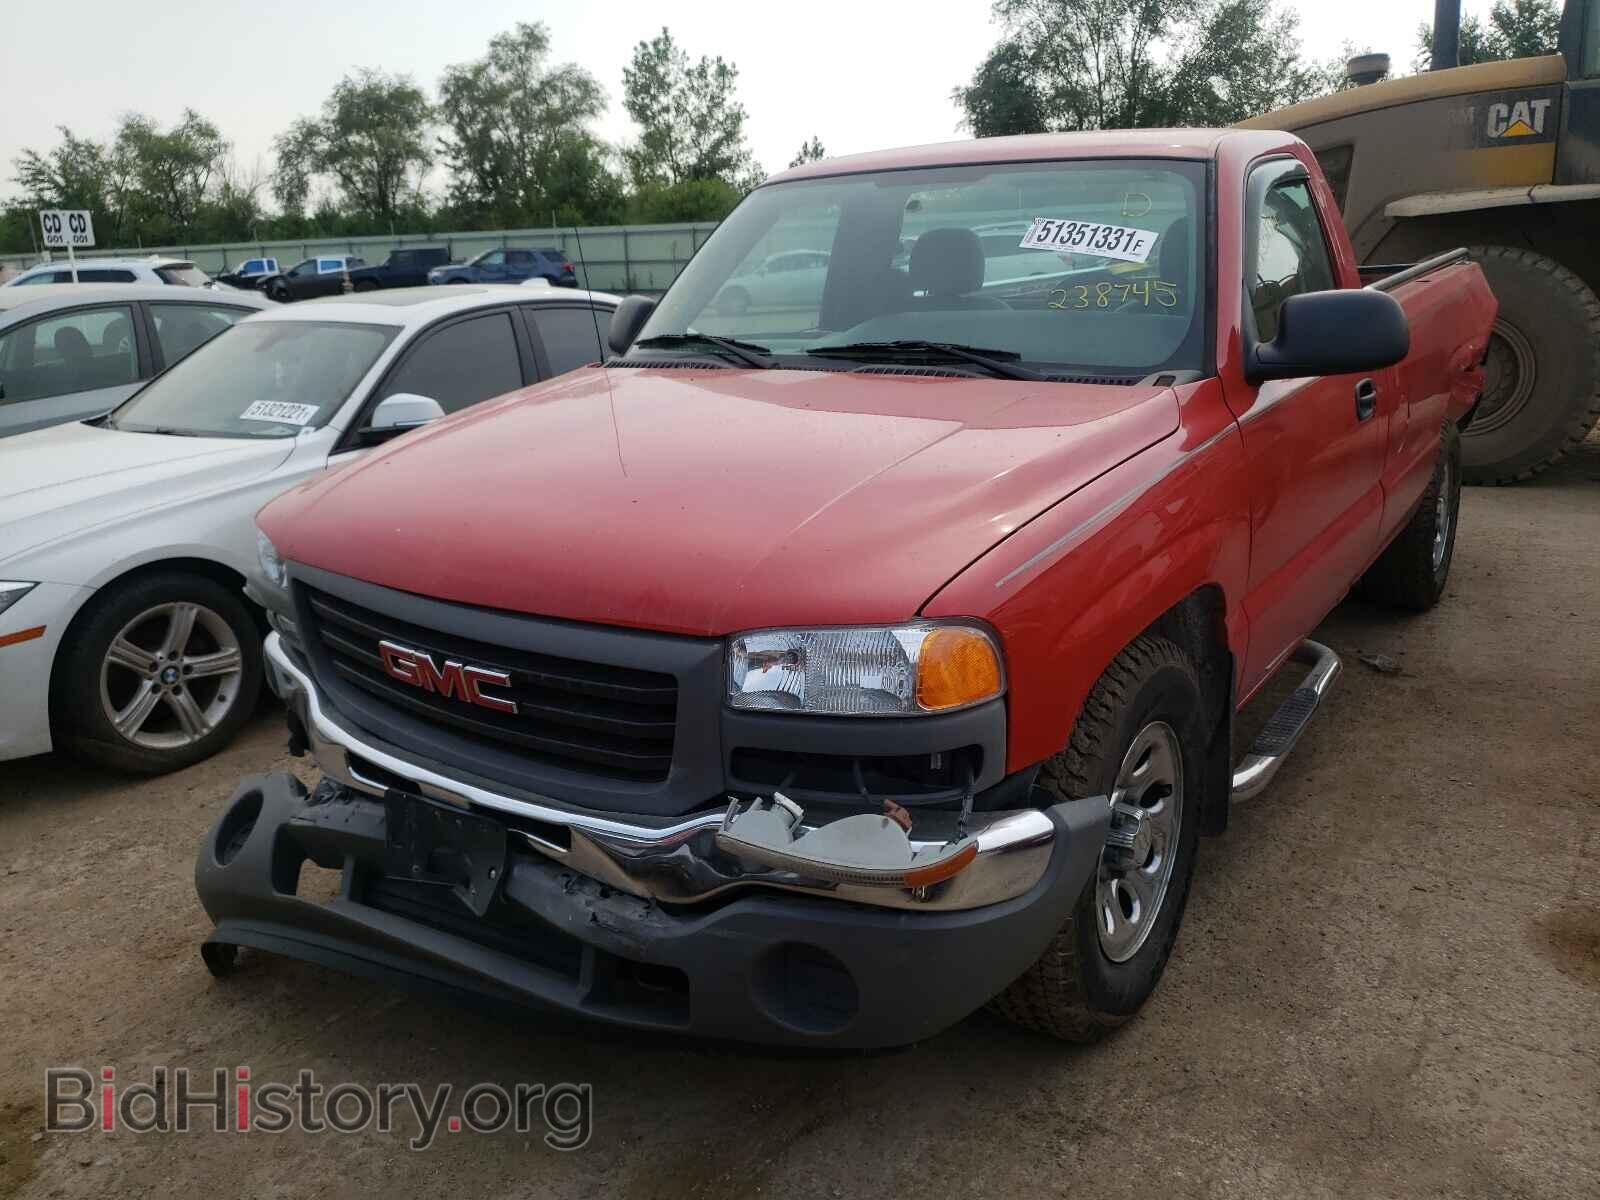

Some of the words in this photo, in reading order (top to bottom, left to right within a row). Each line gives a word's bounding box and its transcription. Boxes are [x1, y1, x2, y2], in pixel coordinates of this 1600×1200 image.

[1487, 99, 1551, 138] CAT
[43, 213, 61, 234] CD
[69, 213, 86, 233] CD
[1048, 280, 1177, 309] 238745
[378, 640, 519, 715] GMC
